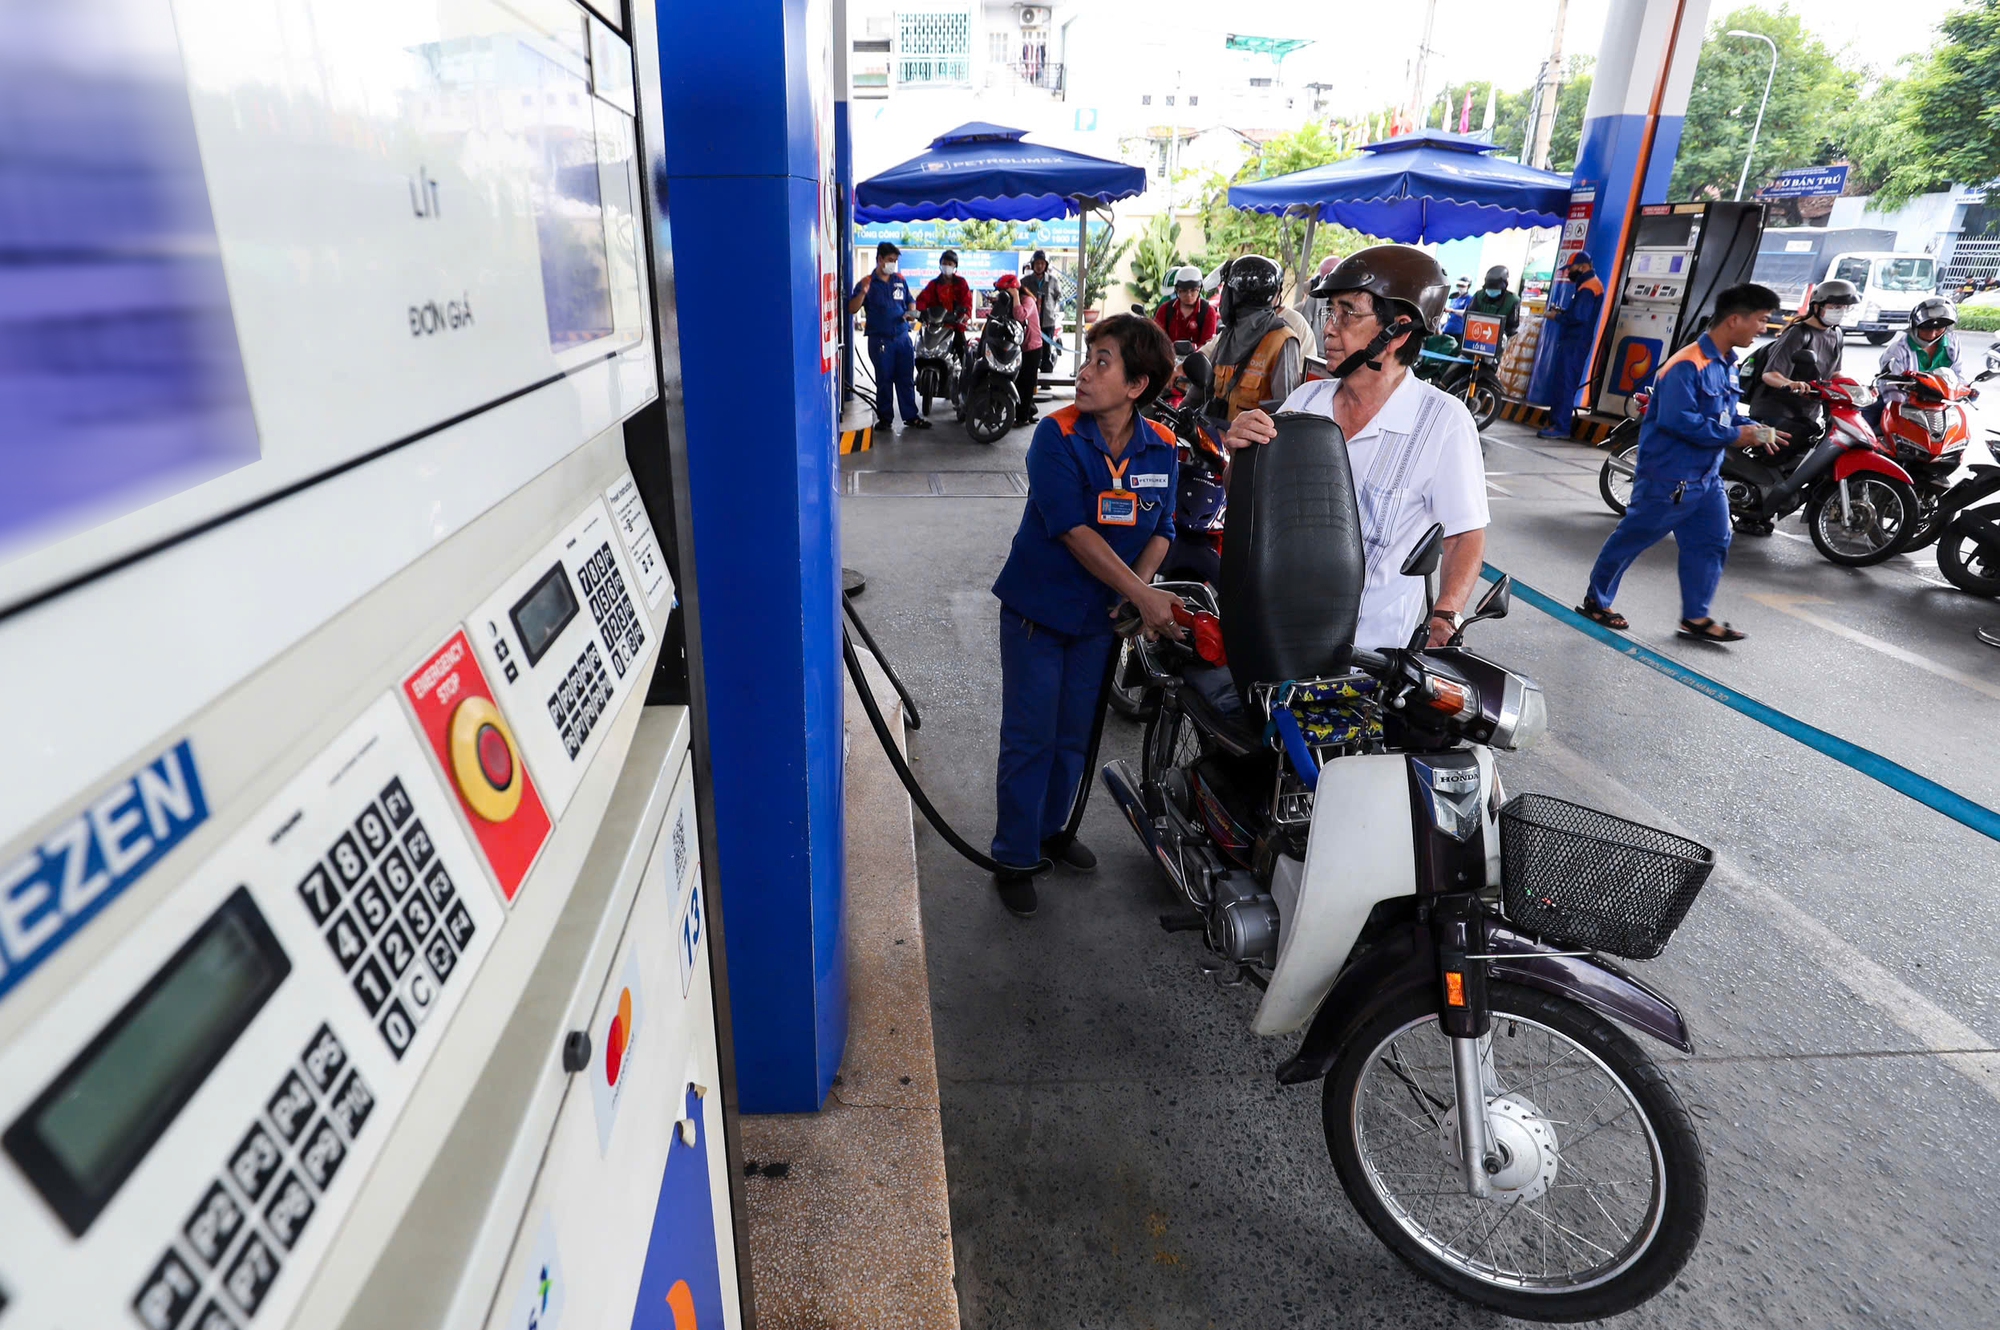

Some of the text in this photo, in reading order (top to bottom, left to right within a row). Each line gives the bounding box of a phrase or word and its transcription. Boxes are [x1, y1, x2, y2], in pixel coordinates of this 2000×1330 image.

[953, 156, 1064, 168] PETROLIMEX
[1792, 176, 1816, 187] BÁN
[1817, 173, 1842, 186] TRÚ
[409, 164, 440, 219] LÍT
[447, 288, 475, 330] GIÁ
[580, 570, 590, 592] 7
[588, 562, 598, 584] 8
[596, 554, 606, 574] 9
[592, 599, 601, 616] 4
[600, 590, 610, 611] 5
[607, 581, 617, 602] 6
[603, 628, 614, 647] 1
[611, 616, 621, 638] 2
[618, 608, 628, 629] 3
[411, 640, 464, 700] EMERGENCY
[436, 671, 460, 704] STOP
[613, 655, 624, 675] 0
[621, 643, 630, 663] C
[549, 699, 565, 727] P1
[560, 684, 574, 712] P2
[570, 671, 583, 698] P3
[579, 658, 592, 684] P4
[1440, 773, 1480, 783] HONDA
[0, 745, 195, 982] EZEN
[303, 788, 407, 914] 7 8 9 F1
[335, 830, 430, 960] 4 5 6 F2
[360, 869, 451, 1002] 1 2 3 F3
[683, 886, 701, 969] 13
[385, 1009, 410, 1047] 0
[410, 974, 431, 1008] C
[137, 1260, 198, 1330] P1
[189, 1189, 240, 1261] P2
[233, 1130, 279, 1194] P3
[271, 1079, 312, 1137] P4
[304, 1032, 344, 1083] P5
[227, 1240, 274, 1309] P7
[303, 1132, 344, 1184] P9
